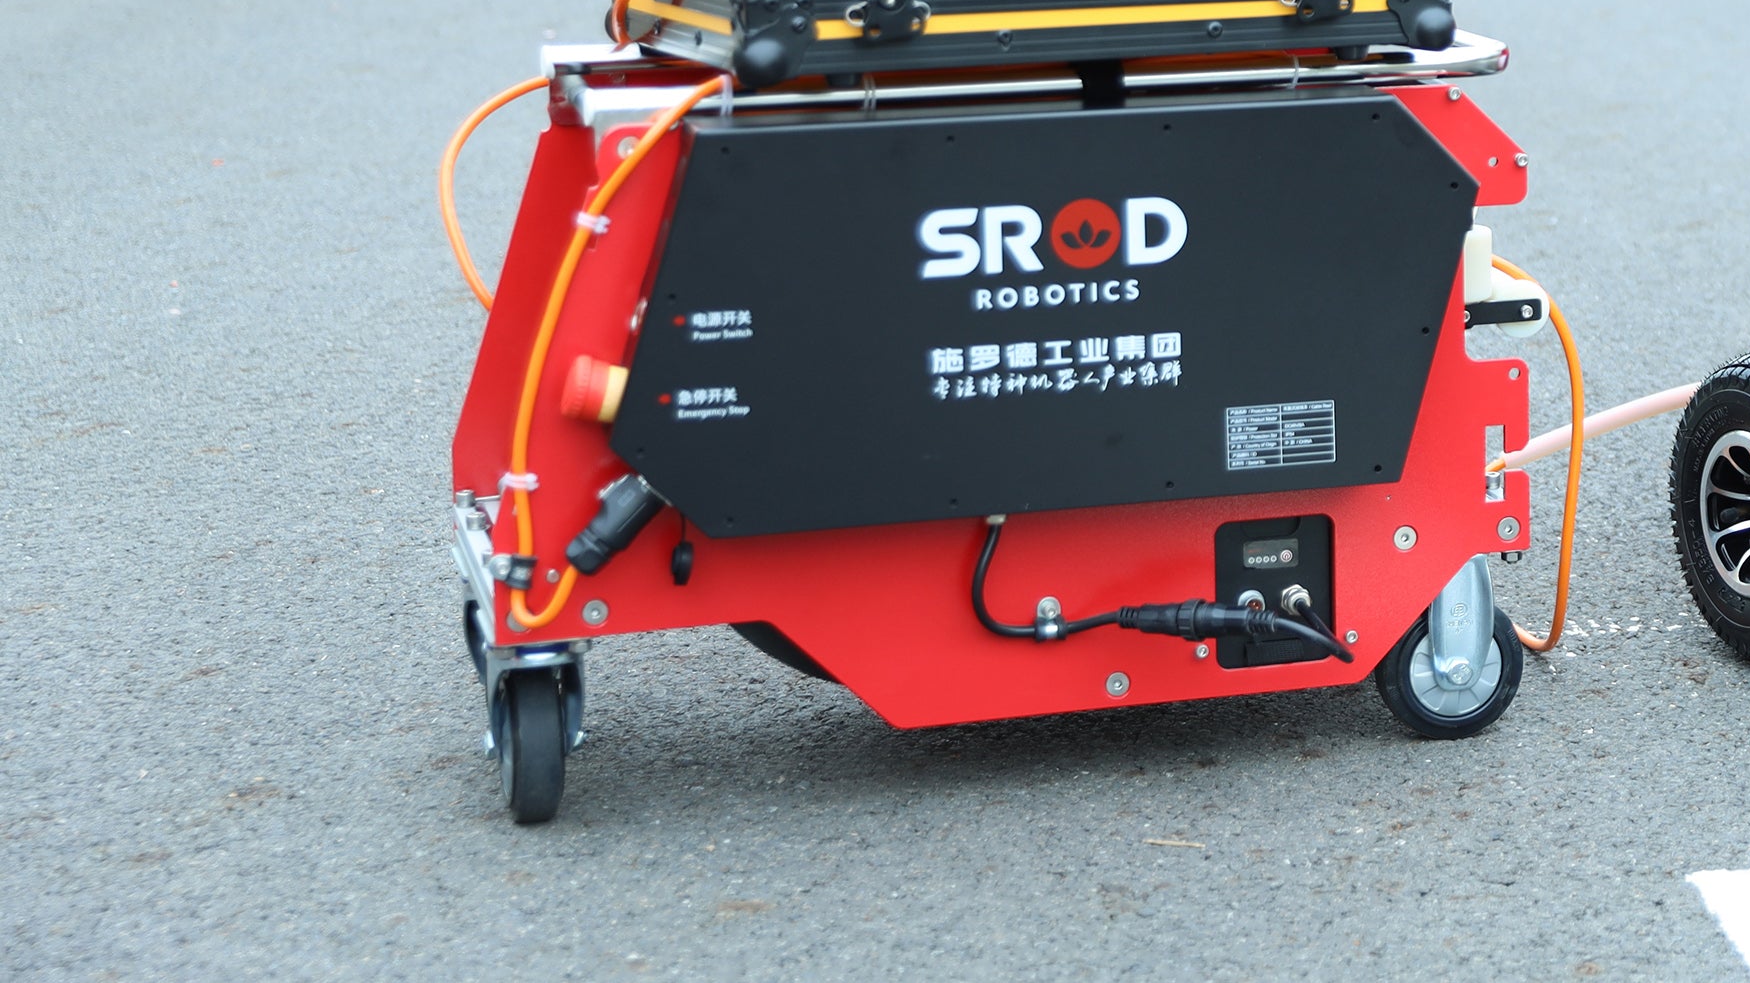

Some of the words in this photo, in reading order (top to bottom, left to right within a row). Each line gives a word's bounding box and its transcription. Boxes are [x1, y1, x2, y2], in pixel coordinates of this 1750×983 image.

[917, 196, 1188, 279] SROD
[975, 279, 1140, 310] ROBOTICS
[693, 310, 752, 328] 电源开关
[692, 331, 722, 341] Power
[723, 328, 753, 339] Switch
[931, 332, 1182, 374] 施罗德工业集团
[678, 387, 738, 406] 急停开关
[677, 409, 727, 420] Emergency
[728, 405, 751, 417] Stop
